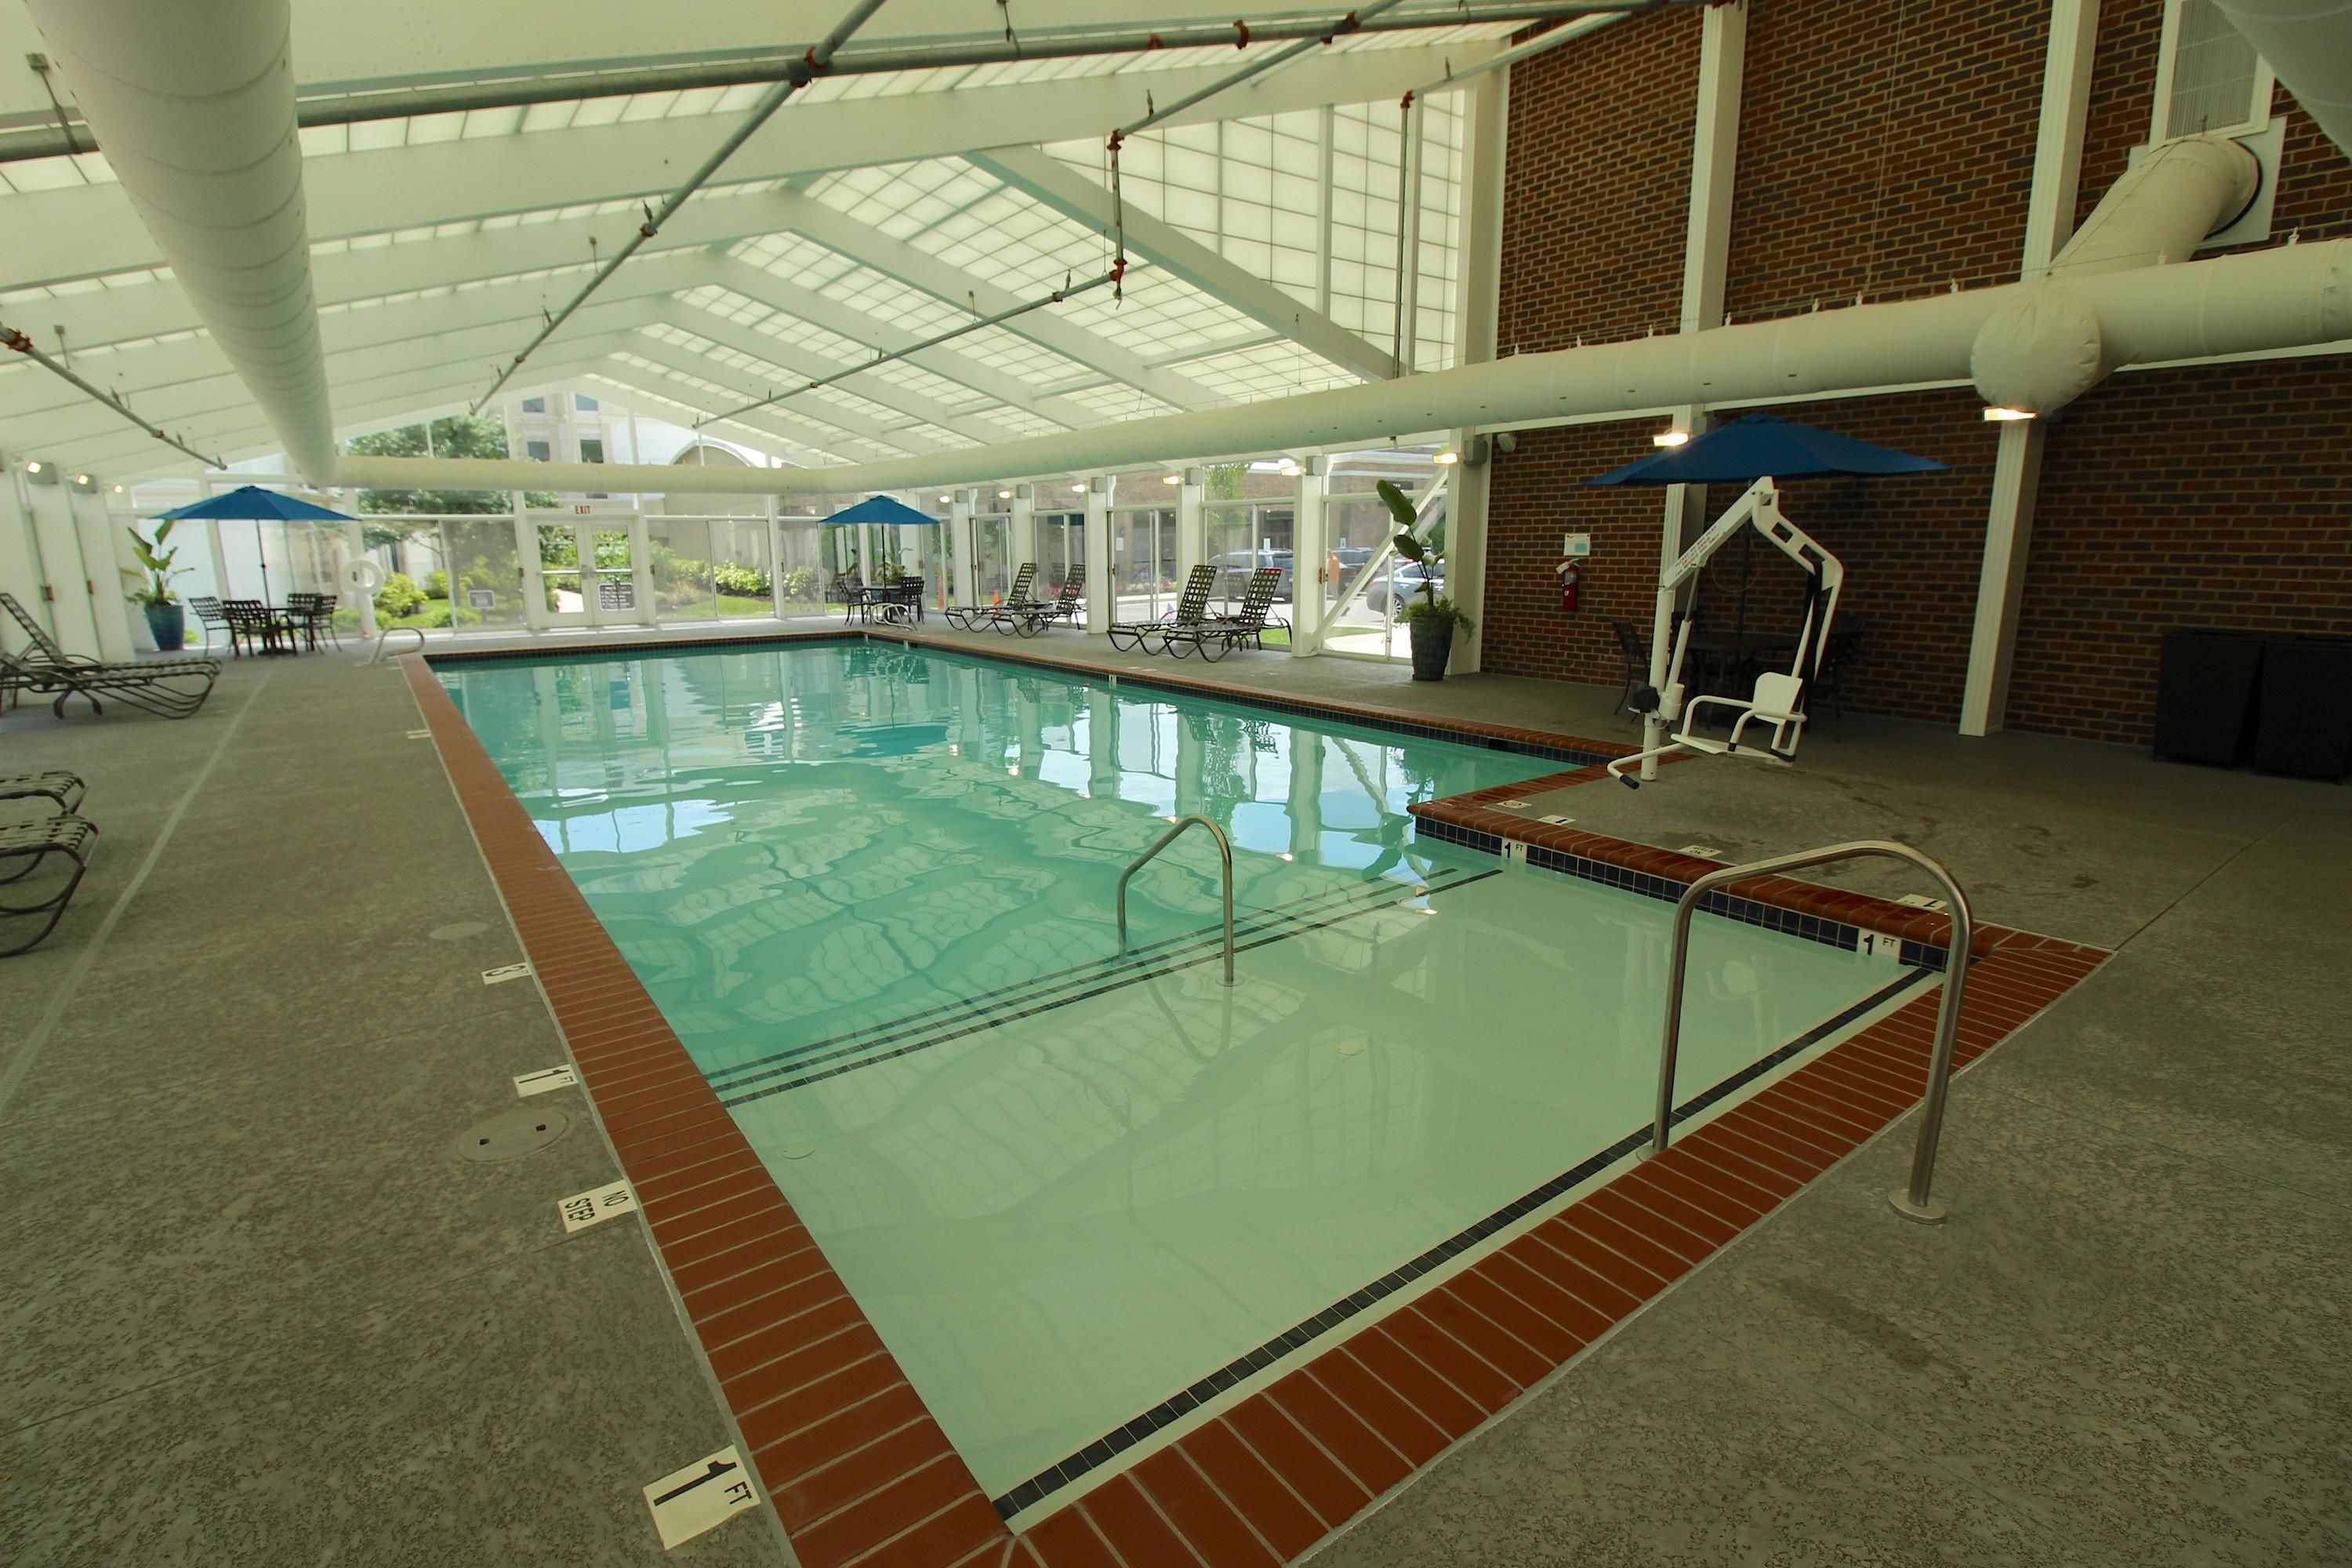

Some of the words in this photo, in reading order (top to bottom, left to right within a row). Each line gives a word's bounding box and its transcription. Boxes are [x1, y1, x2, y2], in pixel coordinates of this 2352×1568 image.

[575, 505, 590, 515] EXIT
[1504, 842, 1511, 858] 1
[1515, 844, 1523, 852] FT
[1864, 934, 1874, 956] 1
[1882, 938, 1896, 947] FT
[485, 965, 526, 977] 3
[519, 1069, 569, 1083] 1
[558, 1076, 574, 1084] FT
[601, 1190, 629, 1207] NO
[564, 1198, 595, 1221] STEP
[653, 1461, 737, 1507] 1
[724, 1482, 752, 1504] FT
